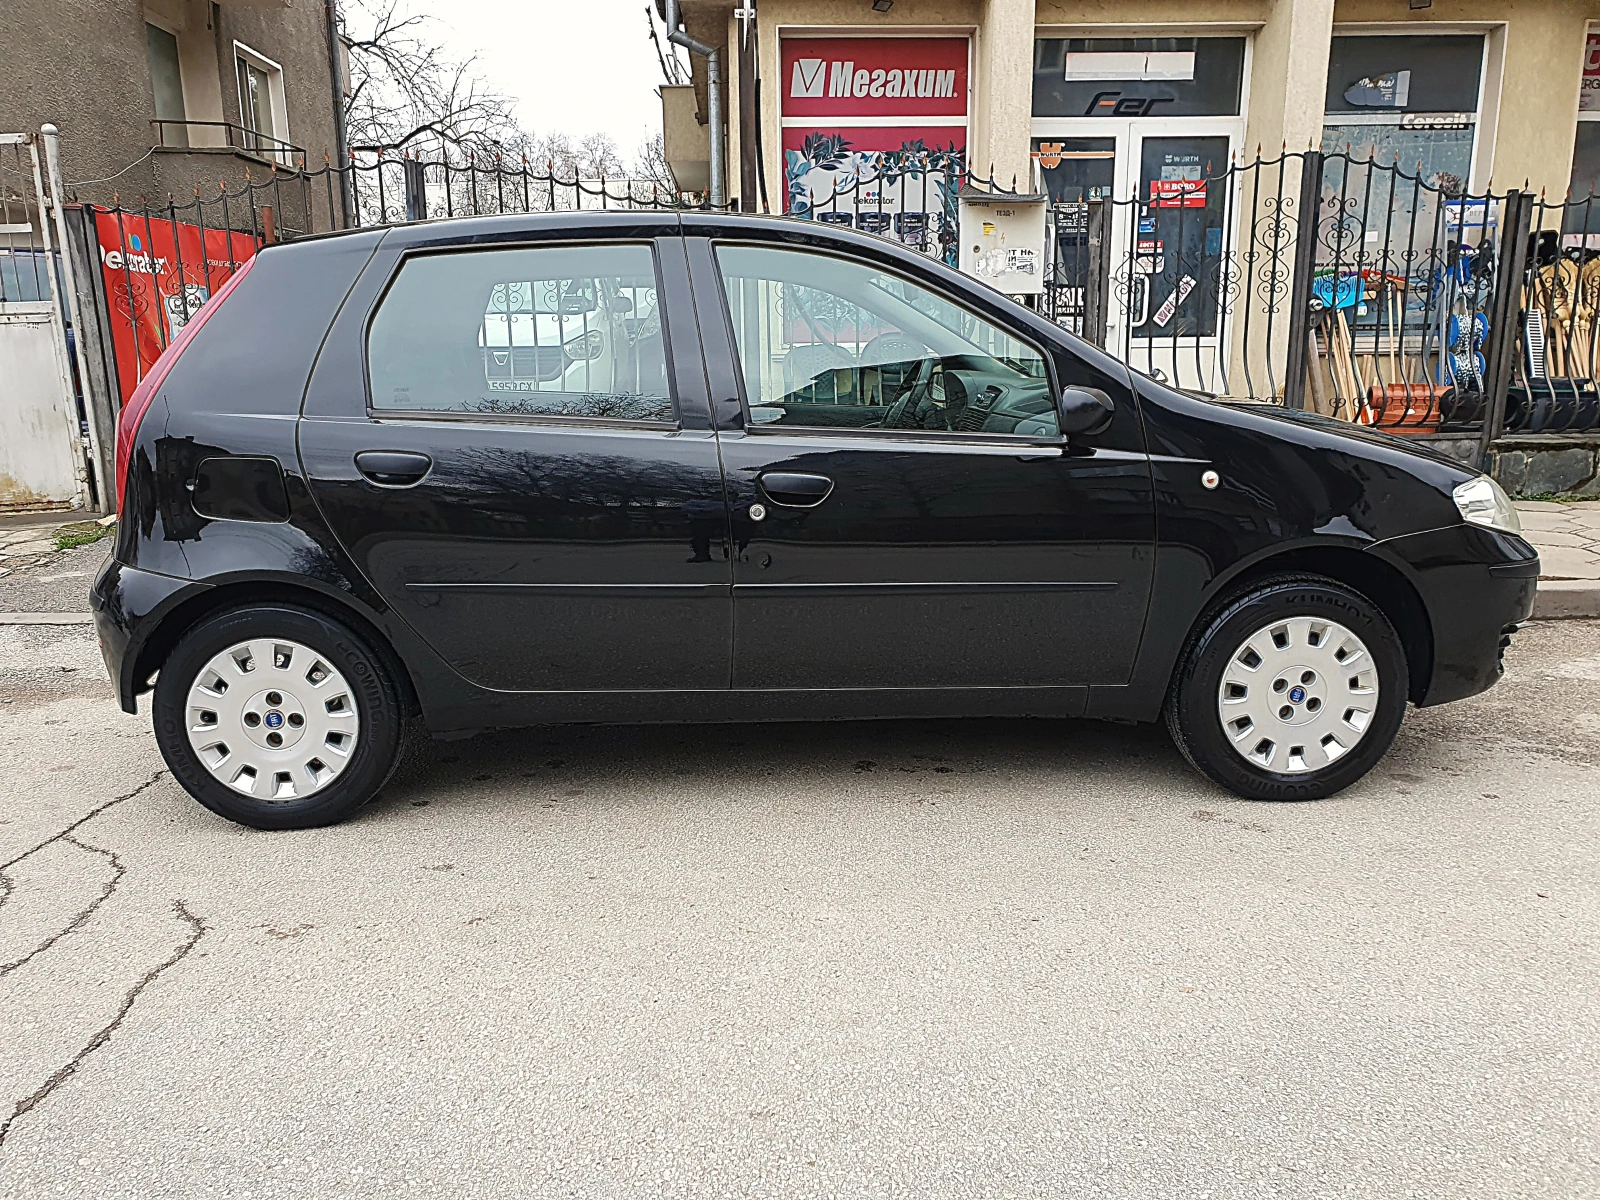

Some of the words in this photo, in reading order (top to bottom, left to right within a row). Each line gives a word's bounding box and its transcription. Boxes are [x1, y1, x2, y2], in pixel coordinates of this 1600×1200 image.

[829, 61, 955, 98] Мегахим
[1084, 91, 1174, 116] Fer
[1402, 113, 1467, 129] Ceresit
[269, 714, 280, 727] FIAT
